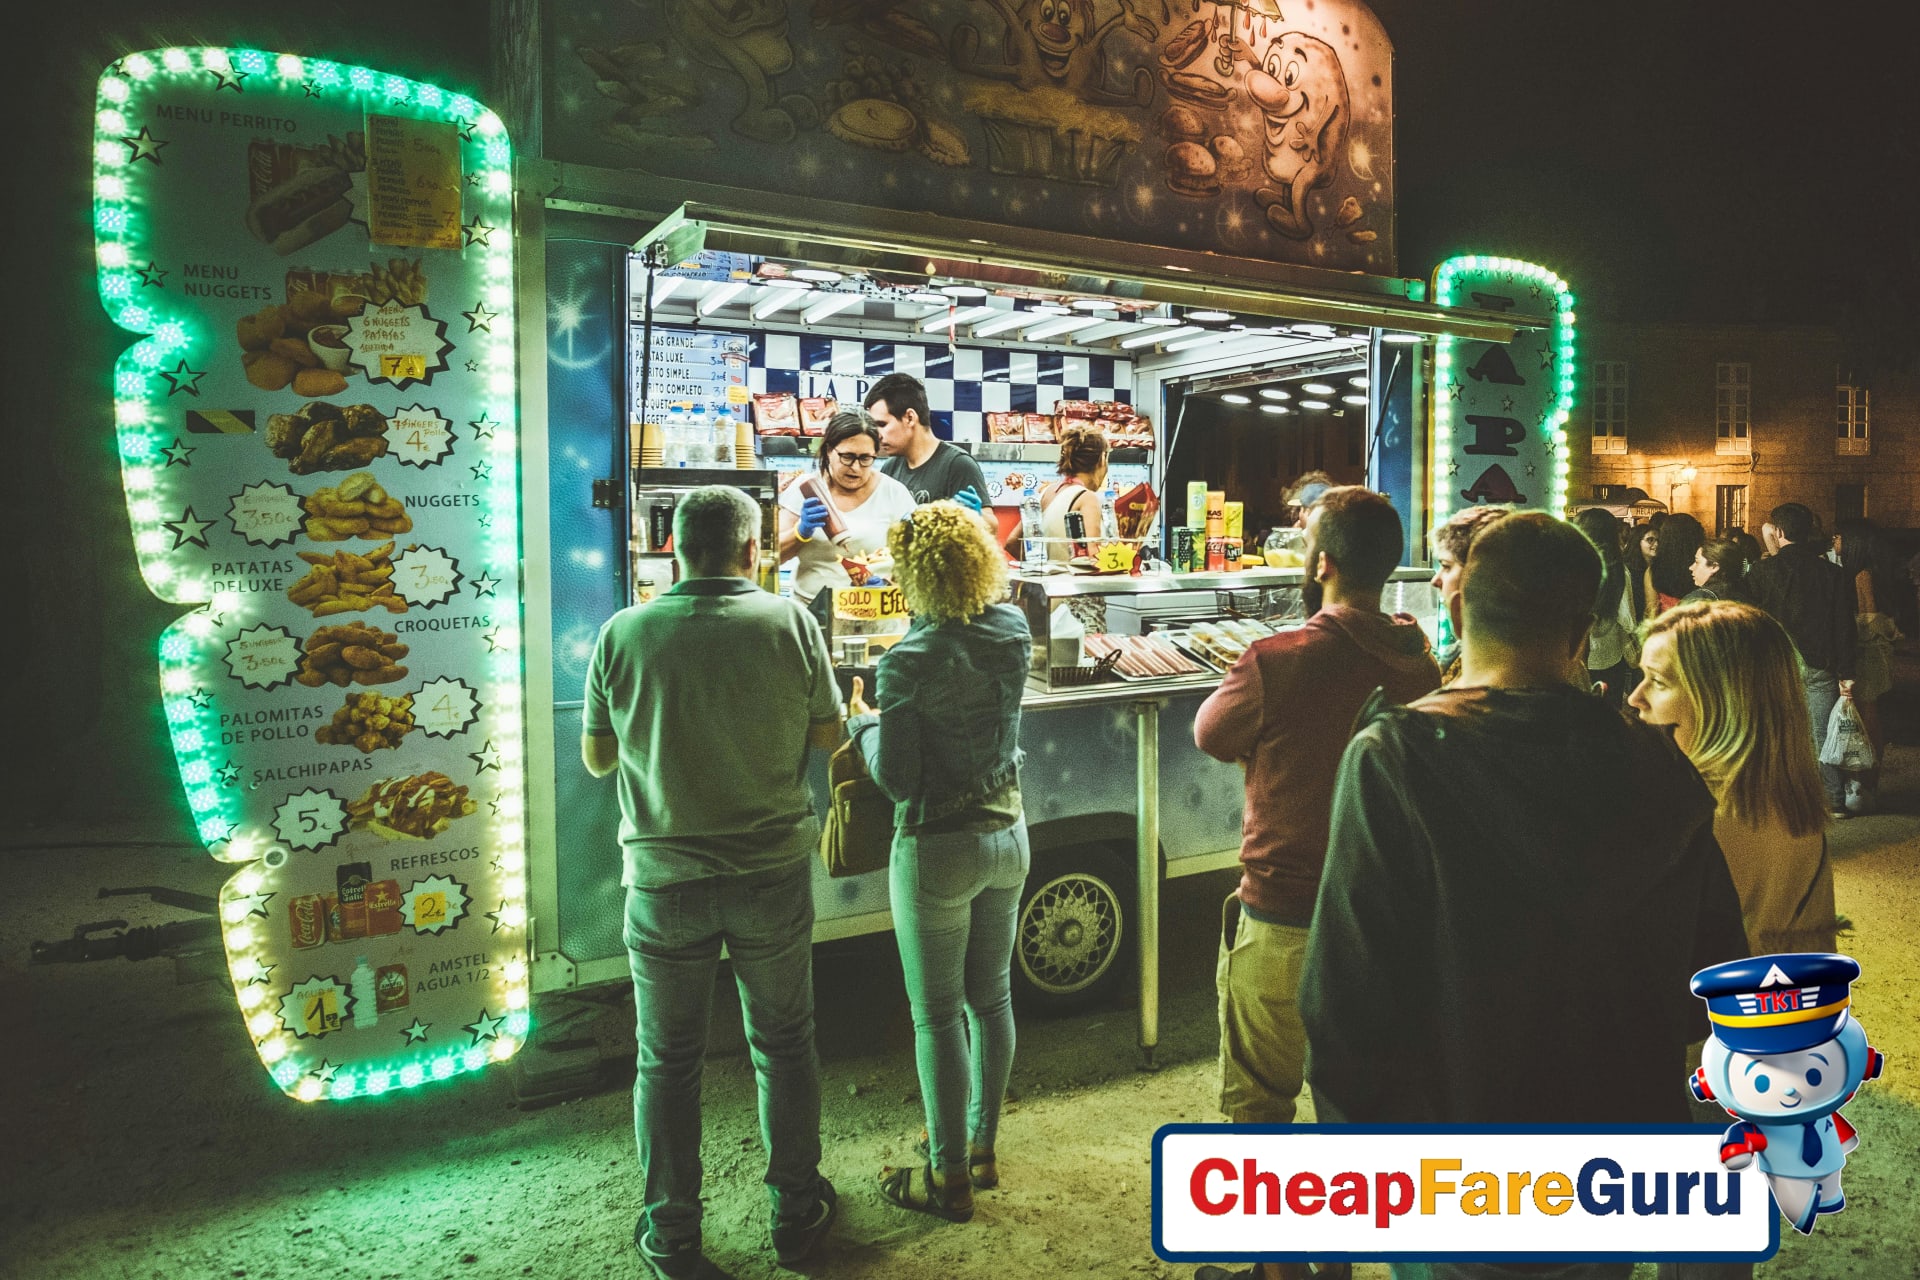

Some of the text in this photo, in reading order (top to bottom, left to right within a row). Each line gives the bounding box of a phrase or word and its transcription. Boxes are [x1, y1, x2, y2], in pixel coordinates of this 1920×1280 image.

[156, 104, 297, 133] MENU PERRITO
[183, 264, 239, 281] MENU
[184, 283, 273, 301] NUGGETS
[635, 334, 664, 347] PATAS
[666, 336, 694, 349] GRANDE
[635, 350, 664, 362] PATAS
[666, 351, 684, 363] LUXE
[635, 366, 664, 378] PERITO
[666, 367, 690, 380] SIMPLE
[666, 384, 702, 396] COMPLETO
[404, 494, 480, 508] NUGGETS
[211, 559, 294, 576] PATATAS
[213, 578, 284, 594] DELUXE
[839, 588, 910, 615] SOLO EFEC
[394, 615, 491, 634] CROQUETAS
[220, 705, 324, 728] PALOMITAS
[221, 724, 309, 745] DE POLLO
[253, 757, 374, 784] SALCHIPAPAS
[390, 846, 480, 872] REFRESCOS
[428, 952, 490, 975] AMSTEL
[415, 967, 491, 994] AGUA 1/2
